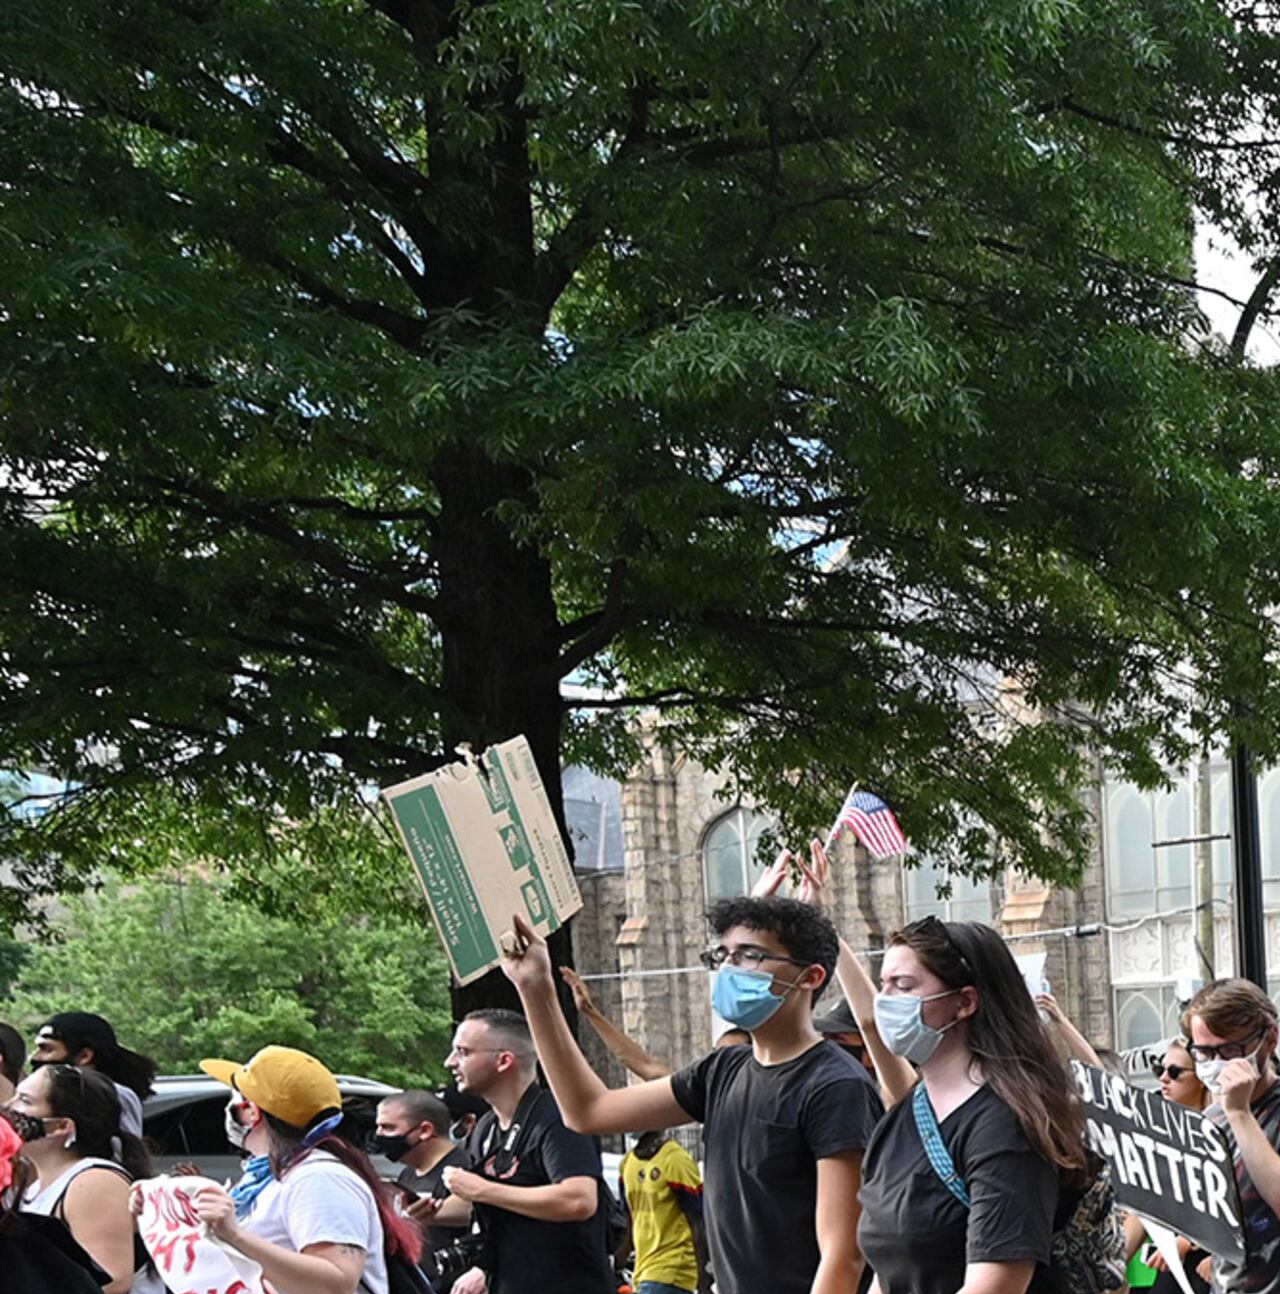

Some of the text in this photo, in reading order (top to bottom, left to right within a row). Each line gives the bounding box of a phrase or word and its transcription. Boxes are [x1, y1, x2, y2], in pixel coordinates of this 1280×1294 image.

[1070, 1059, 1227, 1162] BLACK LIVES
[1085, 1117, 1239, 1227] MATTER
